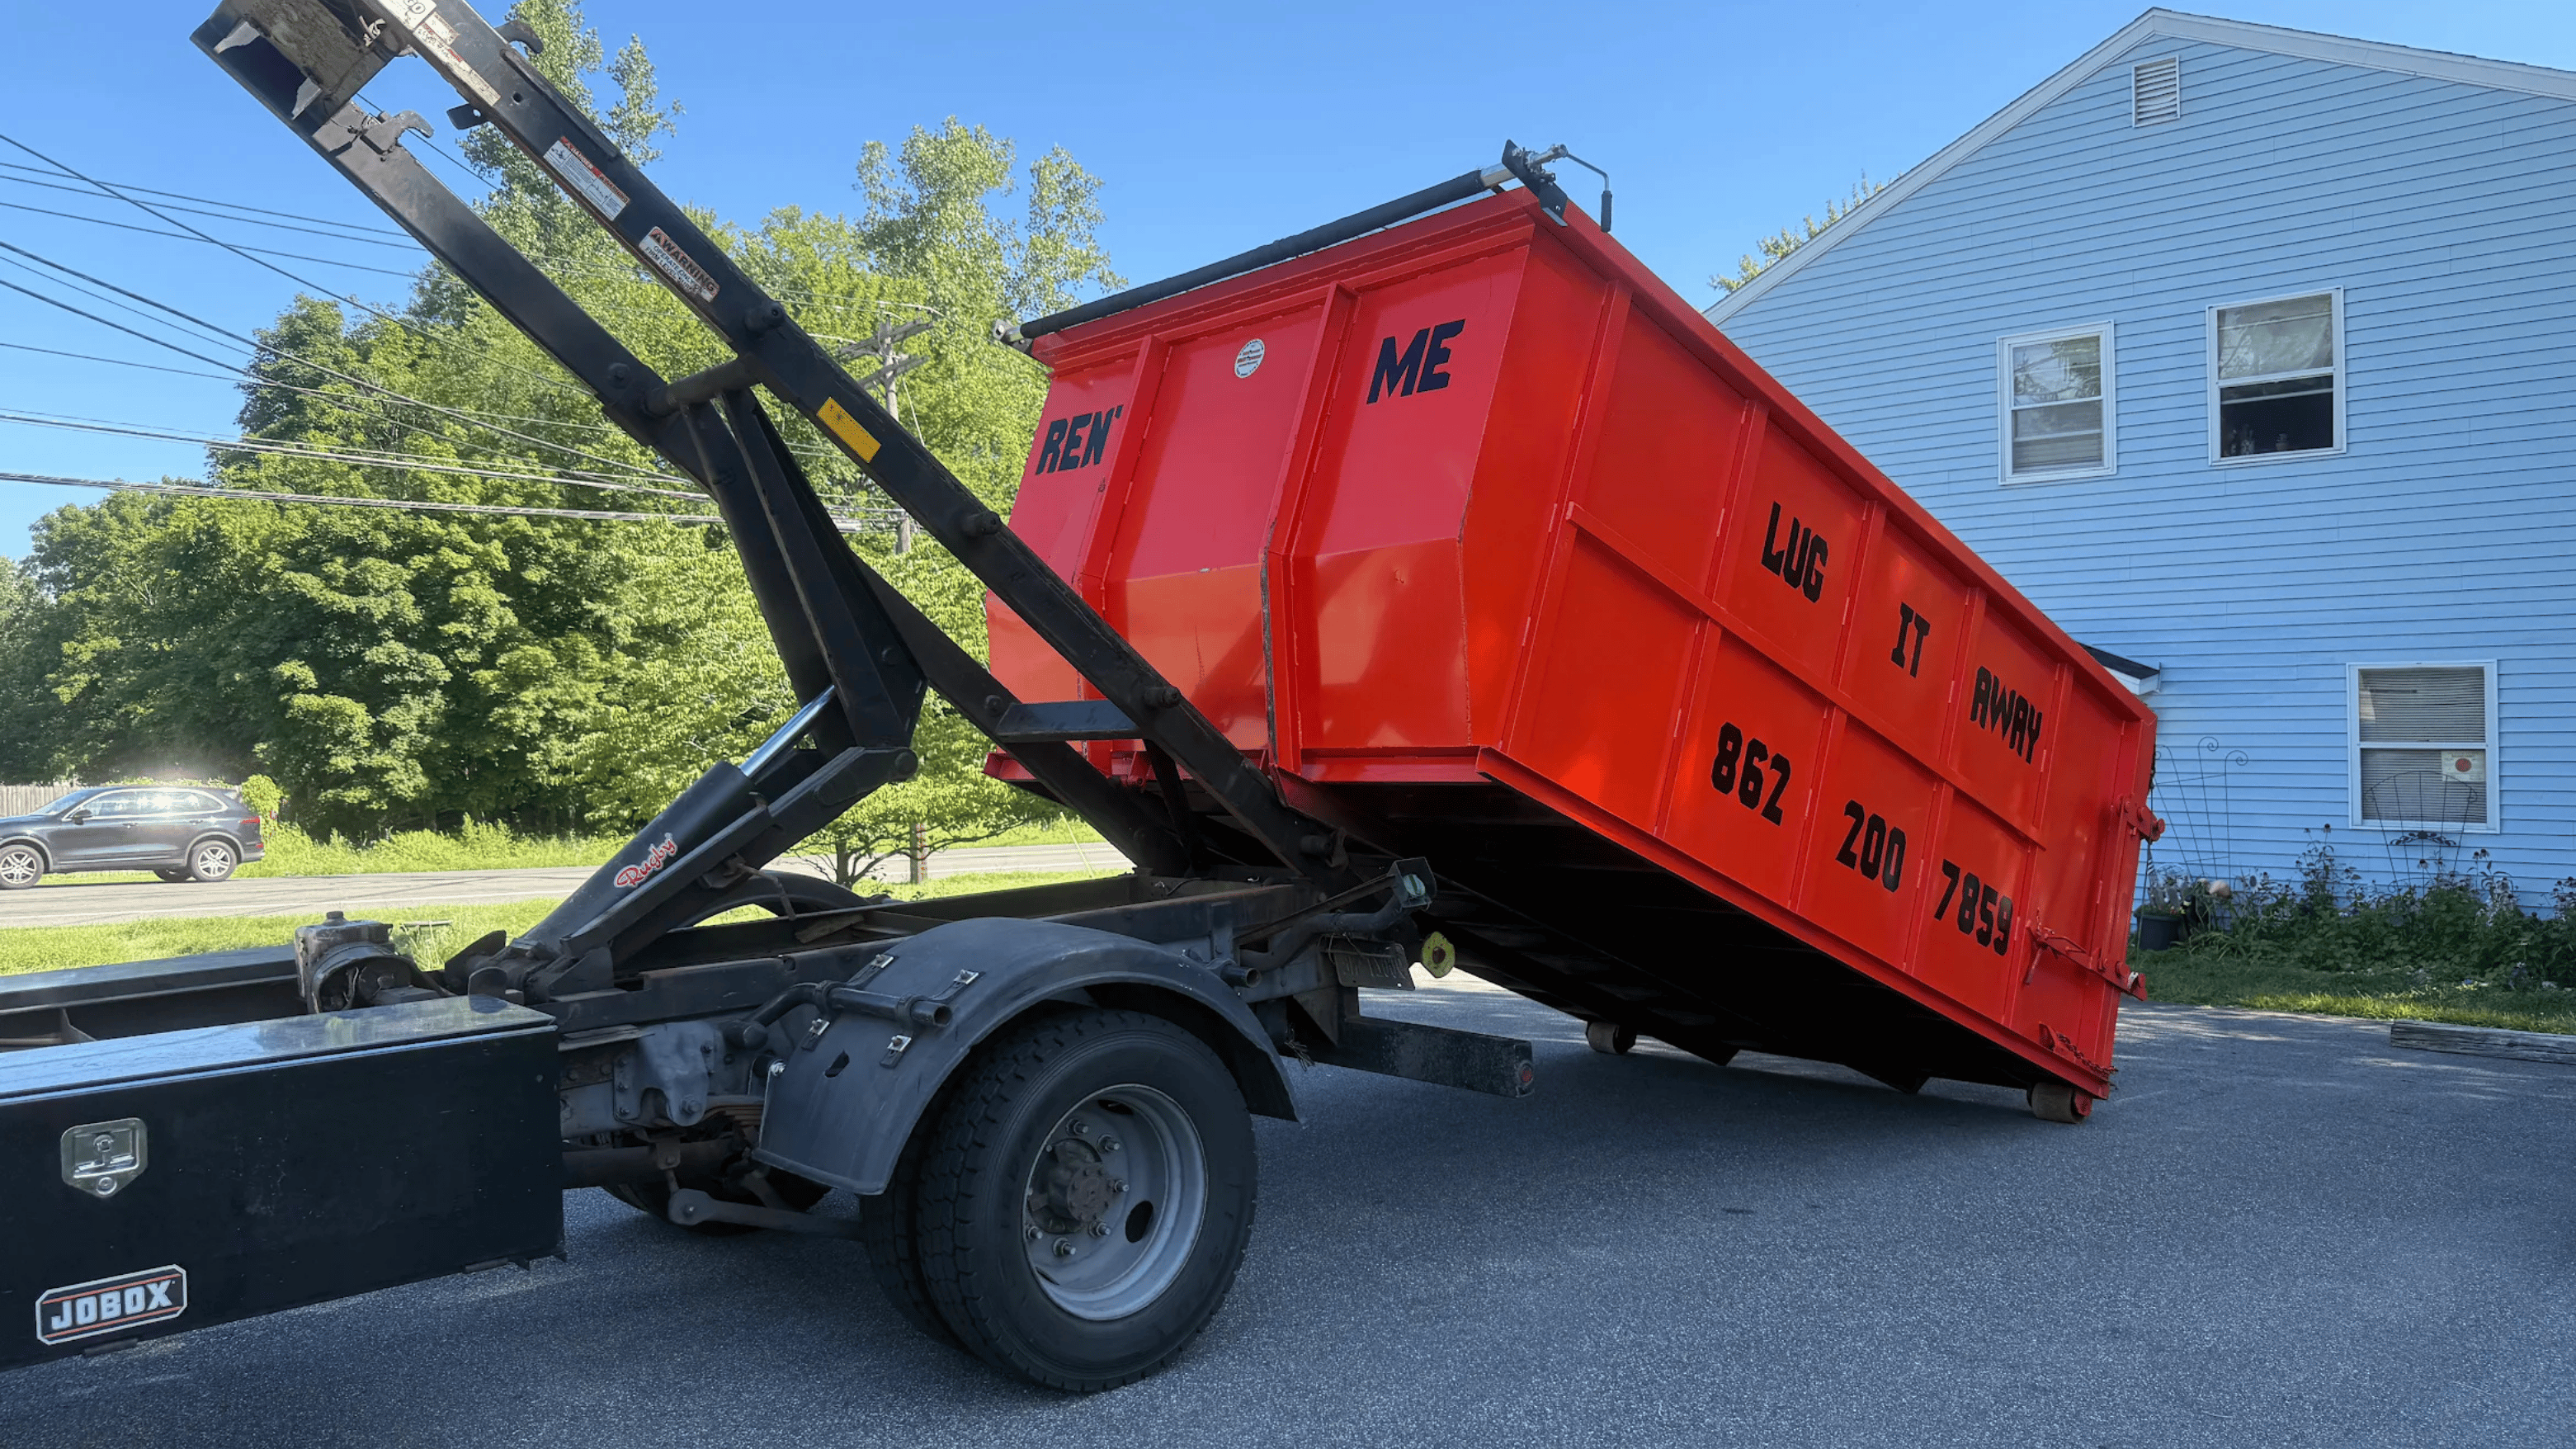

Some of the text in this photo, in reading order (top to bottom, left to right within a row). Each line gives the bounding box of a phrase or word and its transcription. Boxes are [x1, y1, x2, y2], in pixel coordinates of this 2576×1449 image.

[644, 246, 661, 262] FIRM
[652, 244, 680, 271] OPERATE
[677, 268, 695, 285] ONLY
[663, 238, 716, 292] WARNING
[1366, 319, 1465, 404] ME
[1761, 502, 2043, 765] LUG IT AWAY
[616, 837, 677, 886] Rugby
[1710, 722, 2014, 956] 862 200 7859
[50, 1279, 172, 1331] JOBOX
